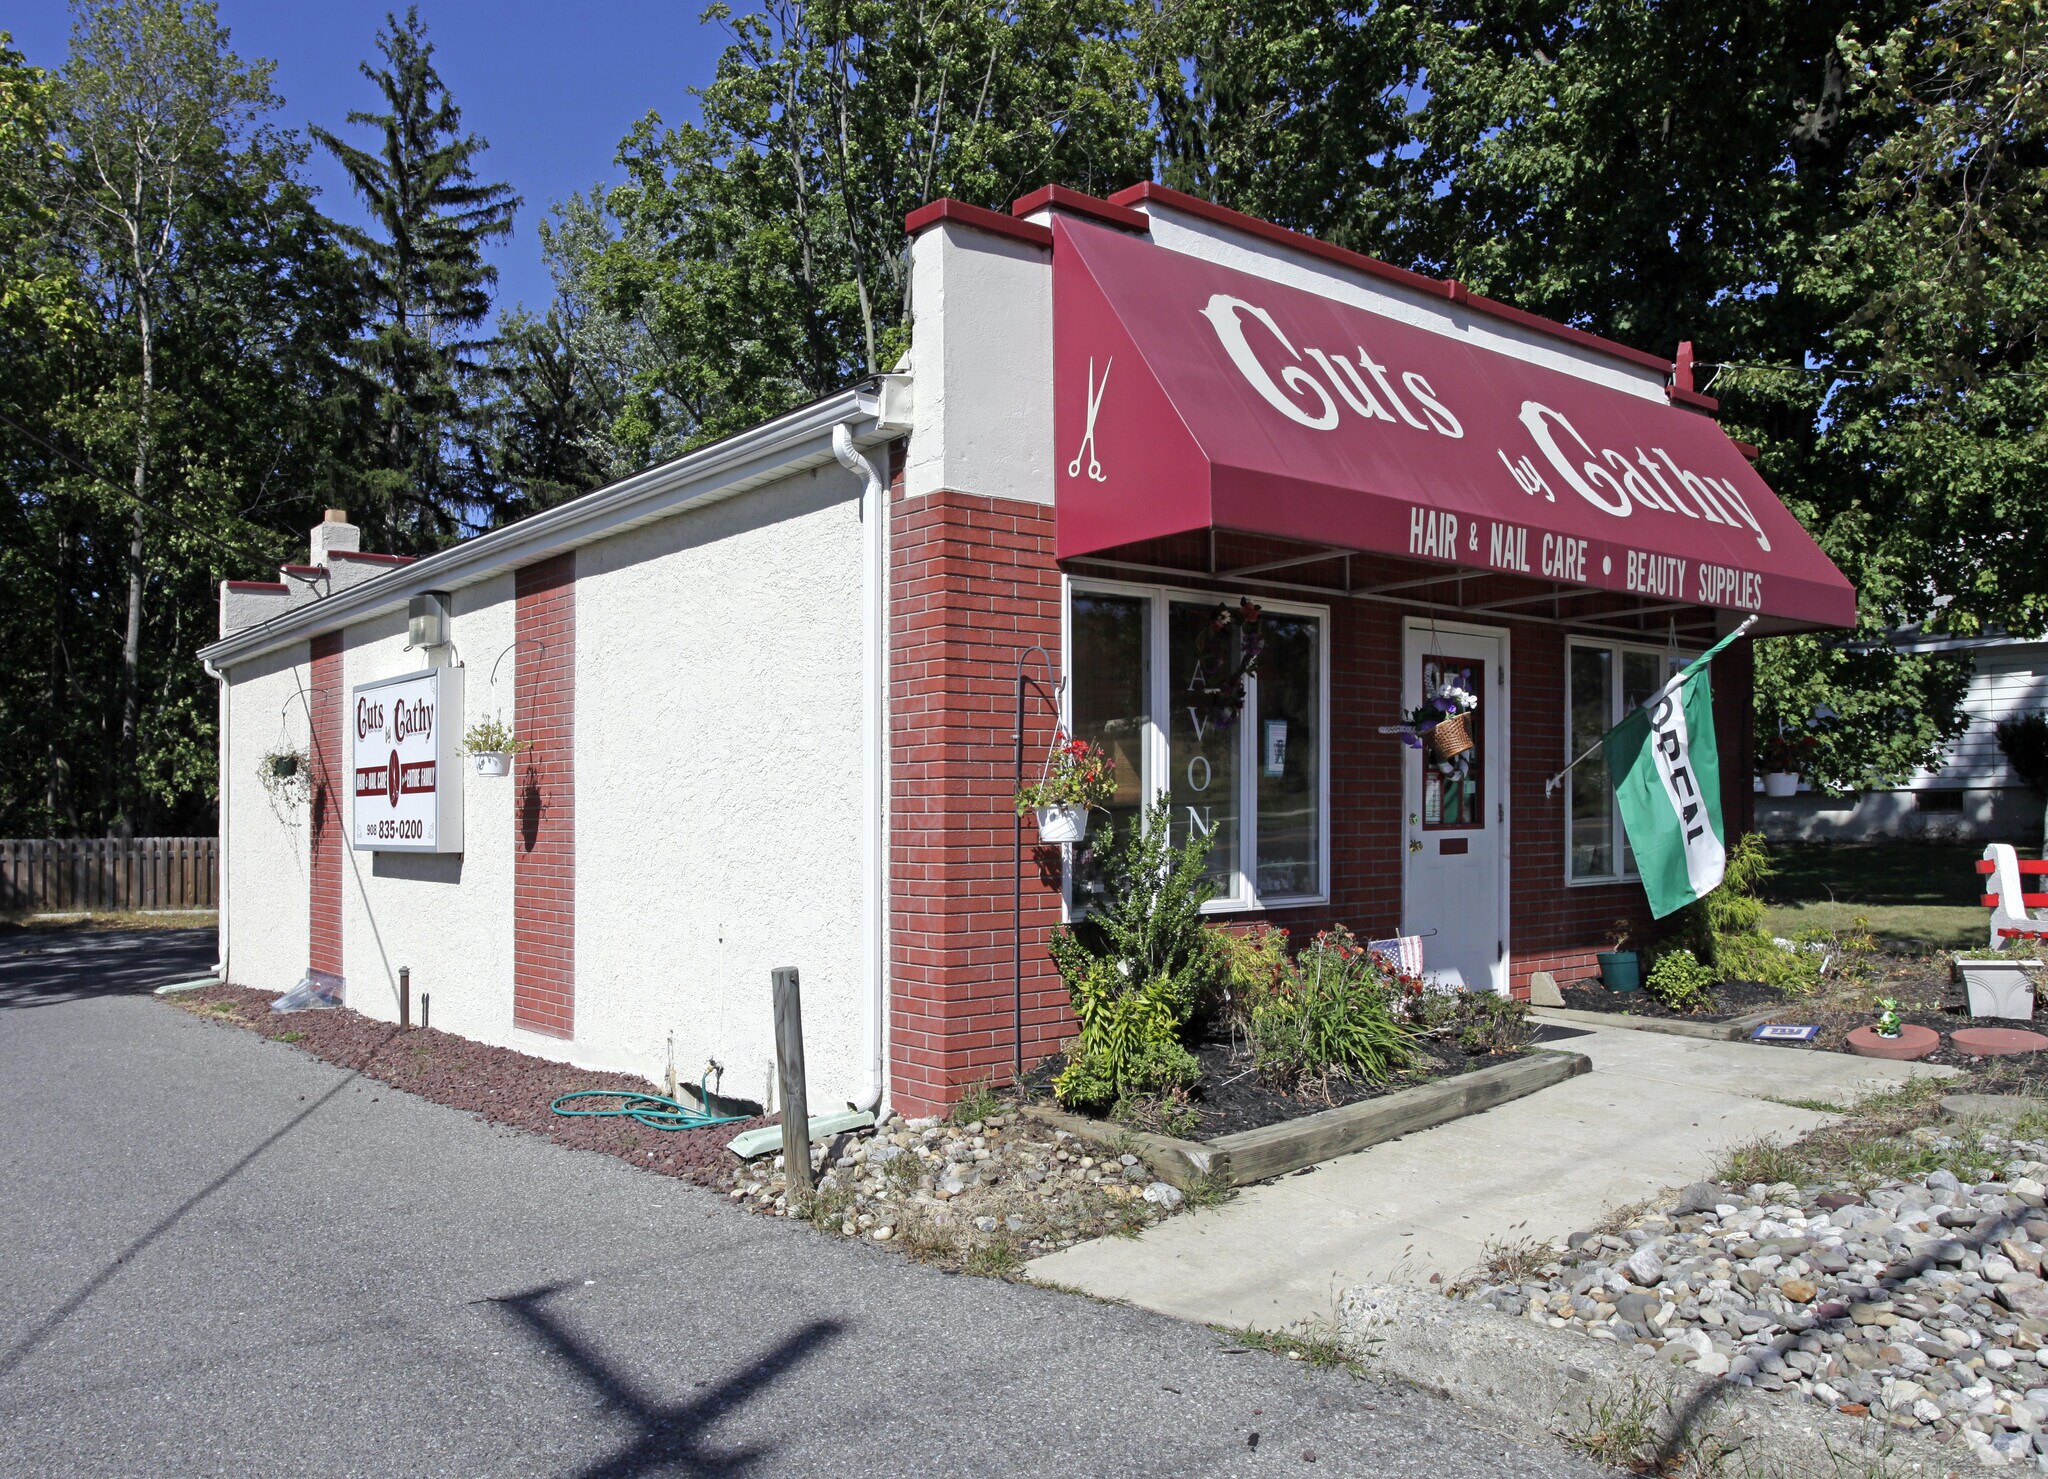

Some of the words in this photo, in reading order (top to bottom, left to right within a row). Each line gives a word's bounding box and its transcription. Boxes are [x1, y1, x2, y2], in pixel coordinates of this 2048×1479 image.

[1198, 294, 1464, 439] Cuts
[1497, 448, 1556, 503] by
[1518, 400, 1771, 552] Cathy
[1409, 507, 1458, 560] HAIR
[1469, 522, 1478, 551] &
[1490, 522, 1531, 572] NAIL
[1542, 533, 1588, 582] CARE
[1627, 550, 1687, 598] BEAUTY
[1699, 563, 1762, 610] SUPPLIES
[357, 696, 384, 739] Cuts
[394, 697, 434, 742] Cathy
[1186, 659, 1212, 841] AVON
[356, 773, 365, 790] HAIR
[368, 772, 377, 790] NAIL
[377, 771, 387, 789] CARE
[420, 767, 435, 787] FAMILY
[367, 824, 377, 836] 908
